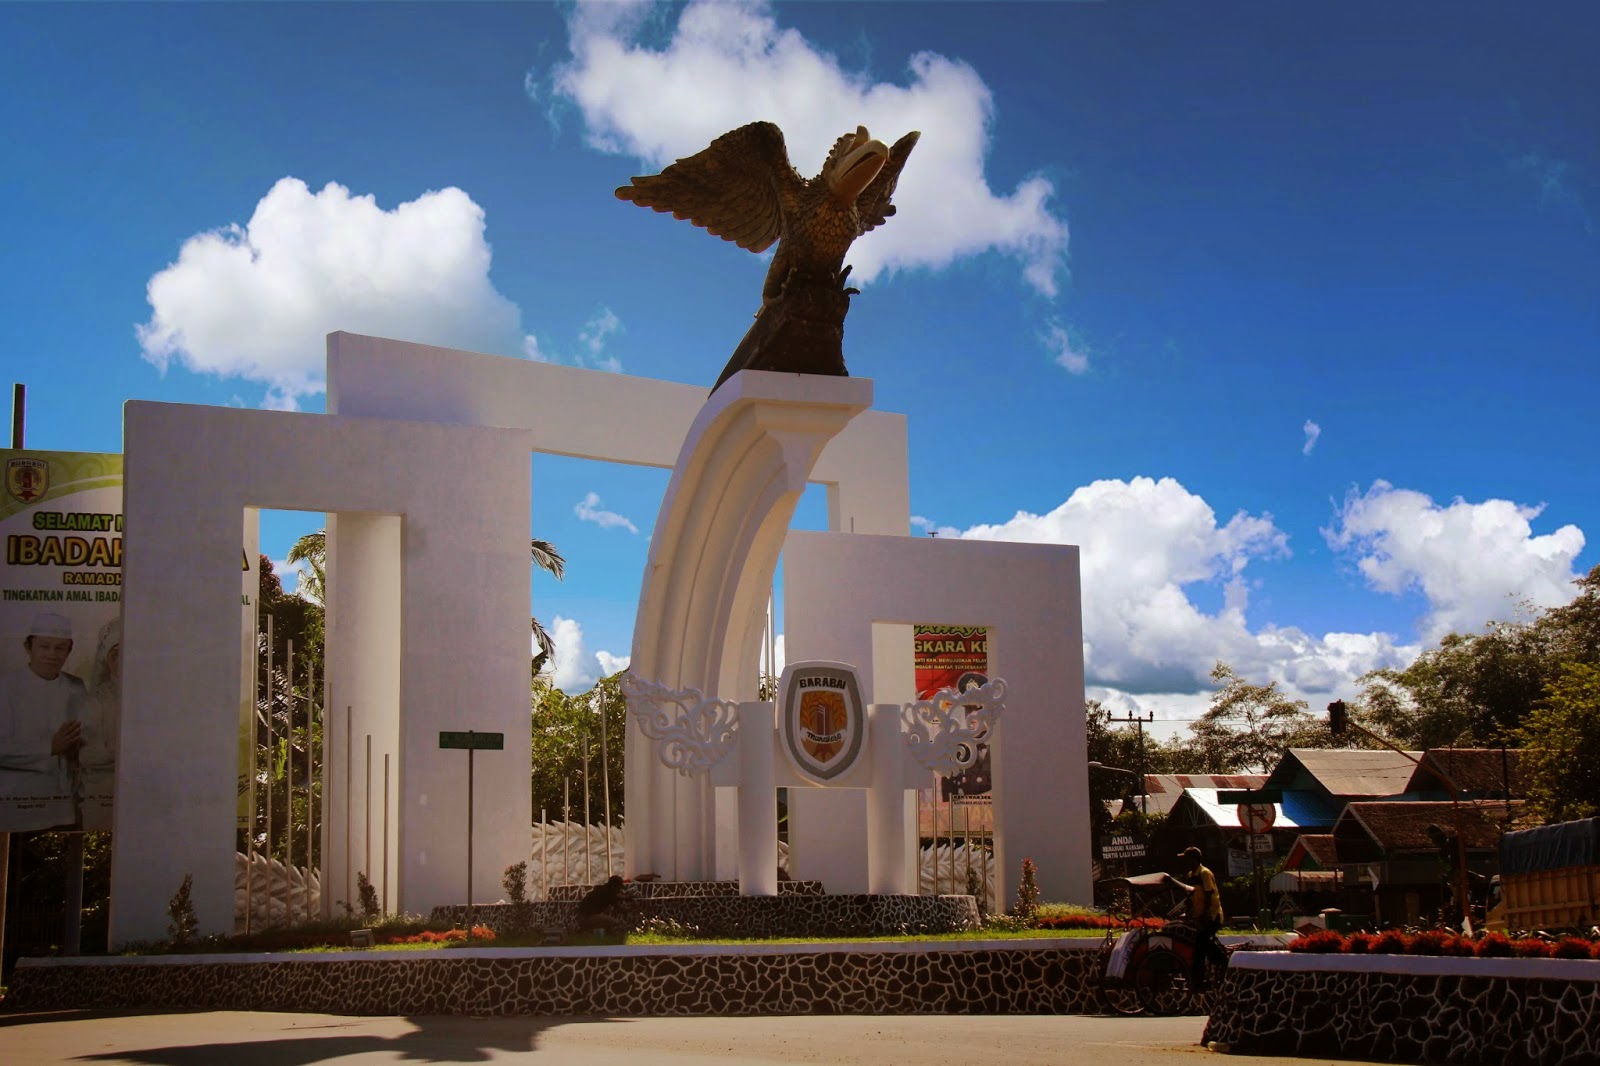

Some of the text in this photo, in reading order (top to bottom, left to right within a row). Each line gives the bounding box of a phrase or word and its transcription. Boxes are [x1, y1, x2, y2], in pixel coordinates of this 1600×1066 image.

[33, 511, 113, 531] SELAMAT
[3, 589, 63, 602] TINGKATKAN
[66, 591, 93, 602] AMAL
[914, 640, 966, 653] GKARA
[800, 677, 847, 690] BARABAI
[1111, 835, 1134, 846] ANDA
[1131, 849, 1146, 858] LINTAS
